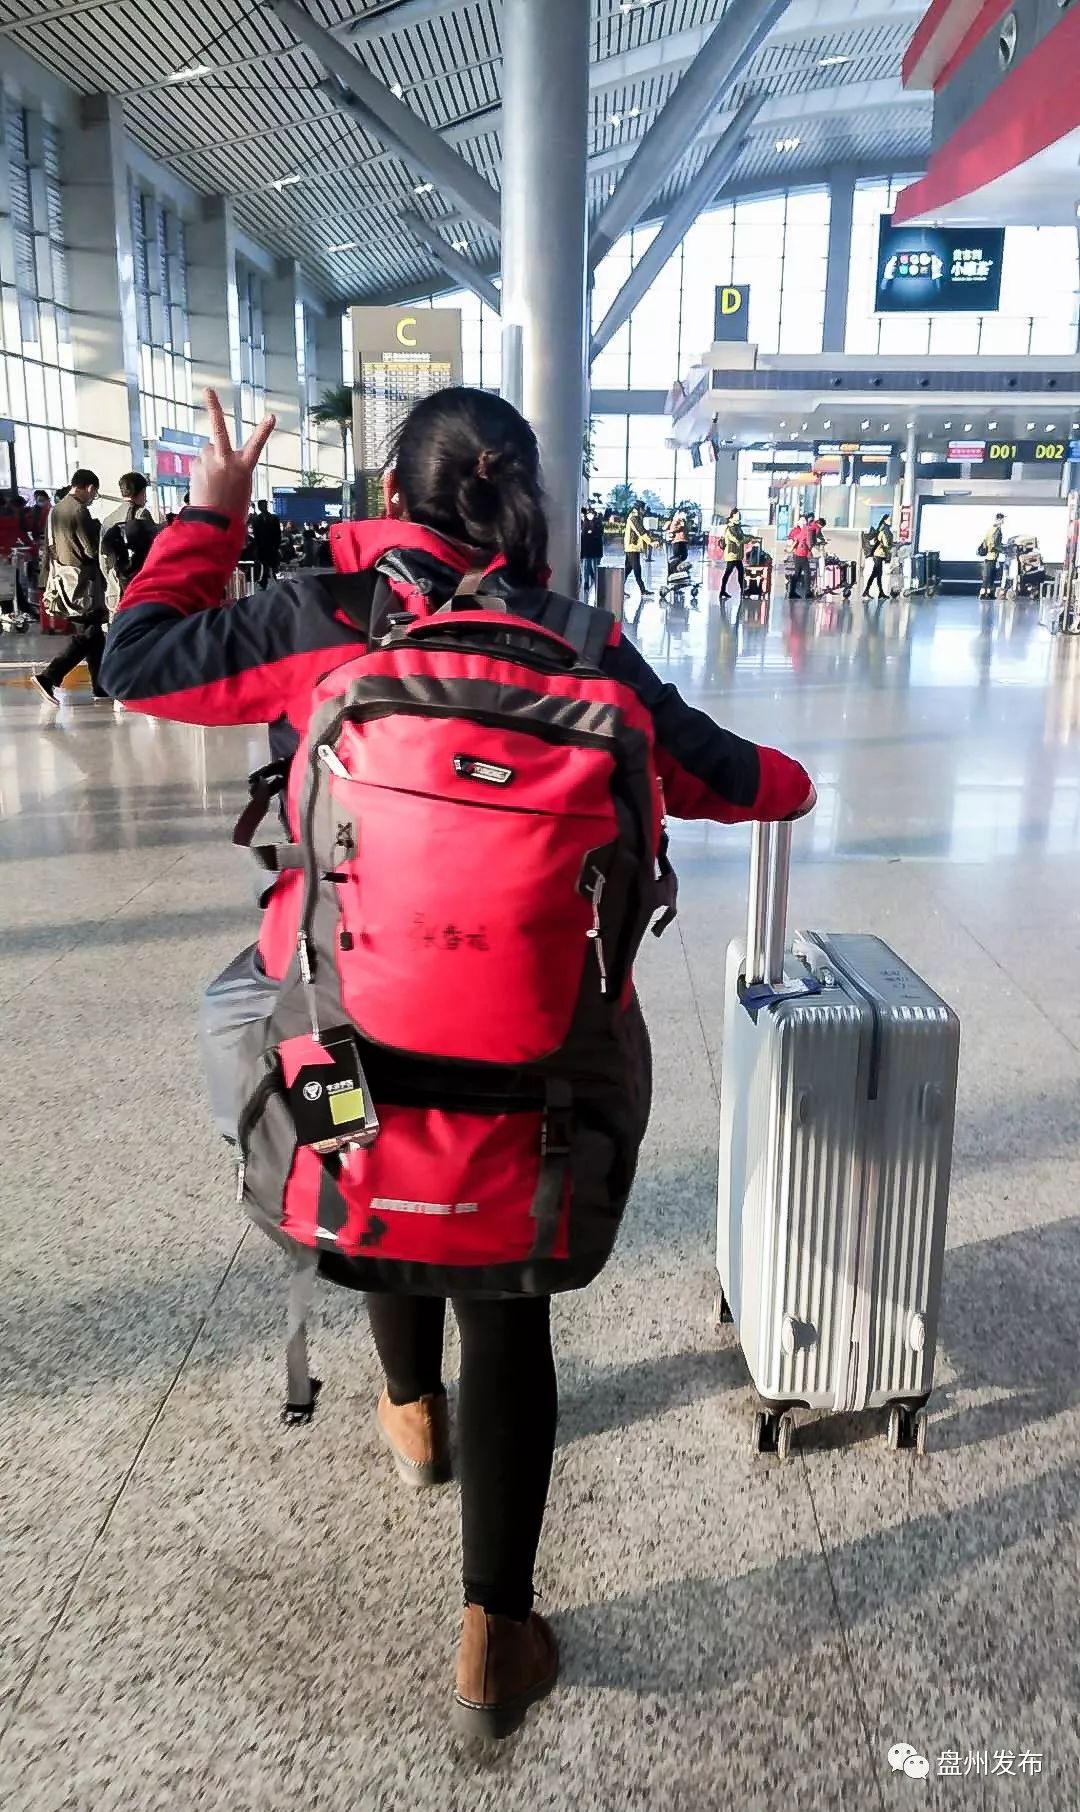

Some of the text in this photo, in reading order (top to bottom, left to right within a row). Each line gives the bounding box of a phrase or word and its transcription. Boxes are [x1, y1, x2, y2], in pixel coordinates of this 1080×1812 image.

[721, 287, 741, 315] D
[396, 317, 417, 347] C
[989, 444, 1017, 459] D01
[1035, 444, 1065, 459] D02
